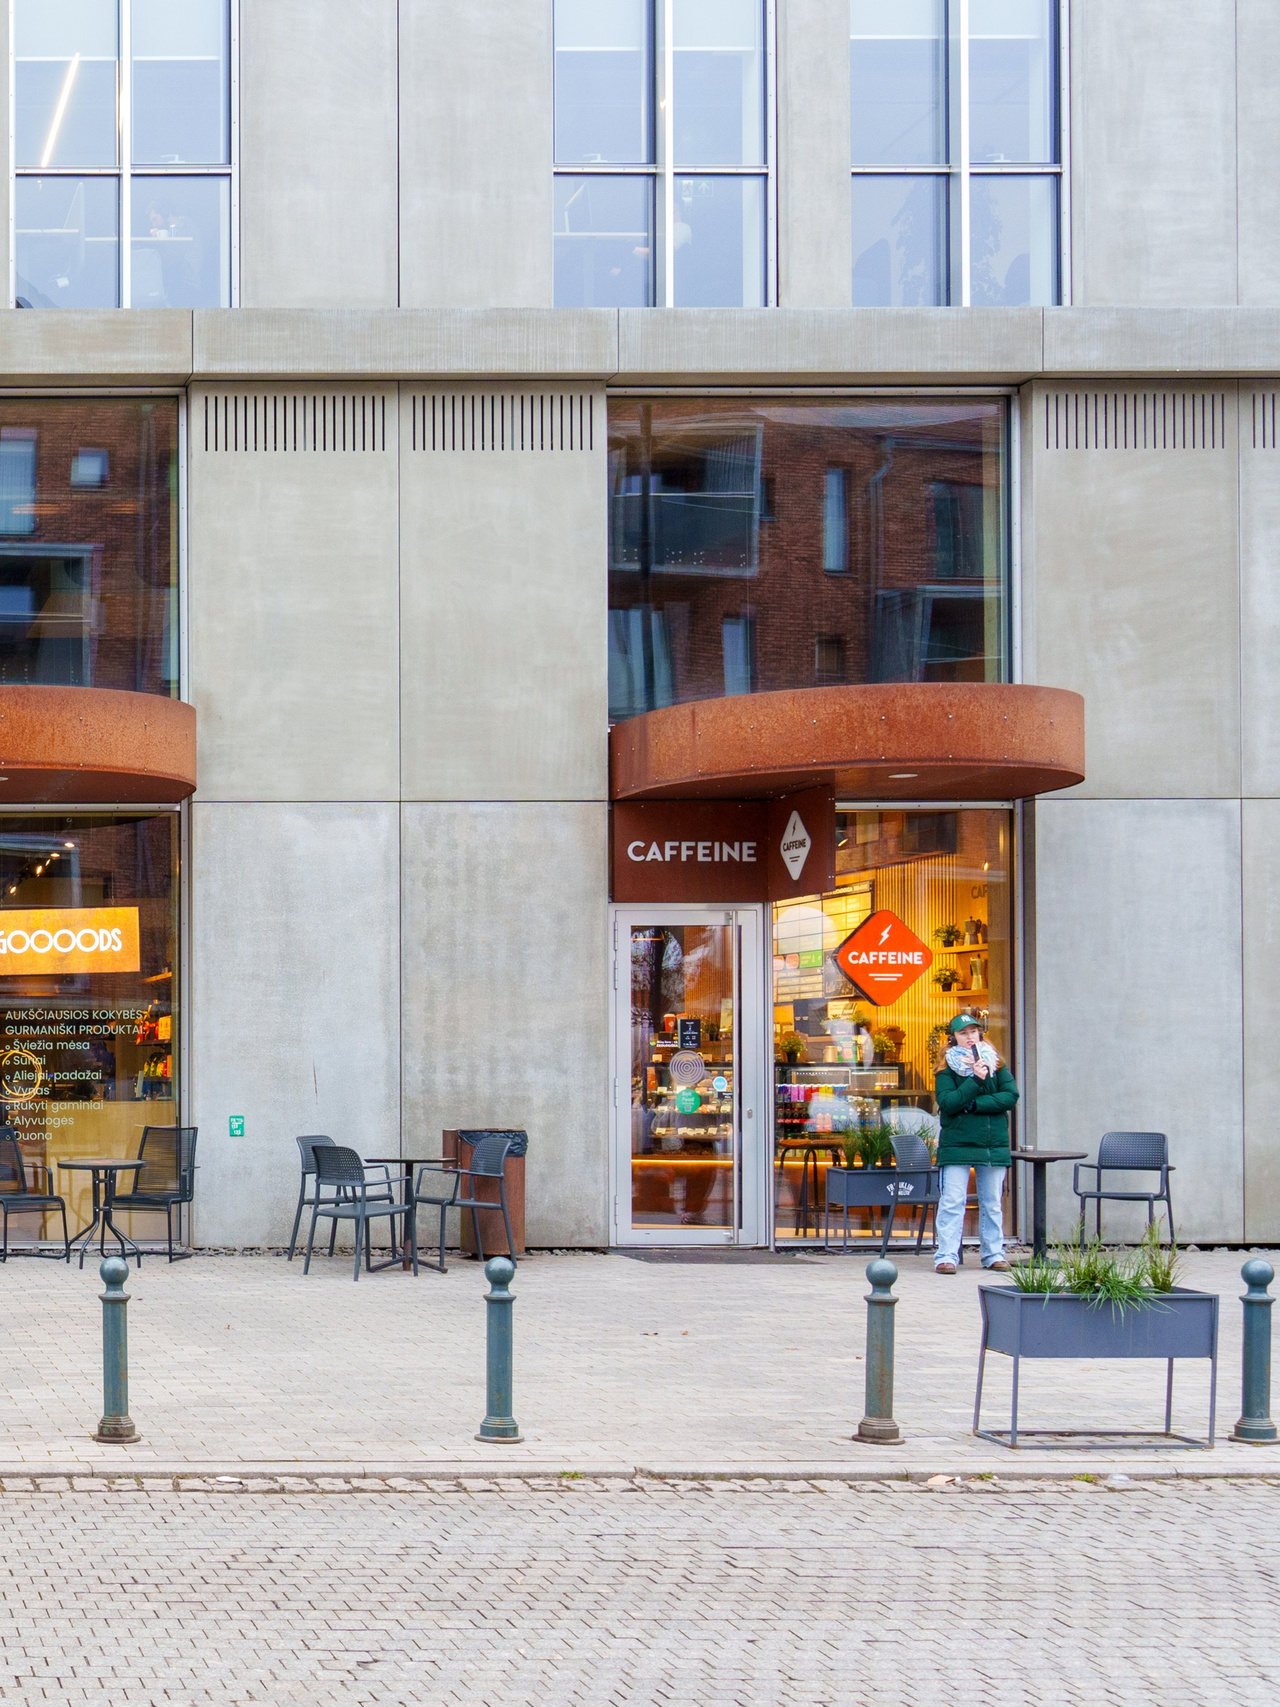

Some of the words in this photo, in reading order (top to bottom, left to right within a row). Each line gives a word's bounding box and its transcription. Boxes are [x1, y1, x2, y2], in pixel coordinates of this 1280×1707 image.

[783, 838, 806, 852] CAFFEINE
[627, 841, 757, 862] CAFFEINE
[848, 951, 923, 965] CAFFEINE
[5, 1008, 89, 1020] AUKŠČIAUSIOS
[92, 1008, 142, 1019] KOKYBĖS
[5, 1024, 75, 1035] GURMANIŠKI
[13, 1039, 53, 1050] Šviežia
[57, 1040, 90, 1050] mėsa
[13, 1071, 50, 1082] Aliejai,
[53, 1070, 102, 1082] padažai
[14, 1101, 47, 1112] Rūkyti
[51, 1101, 104, 1113] gaminiai
[14, 1116, 74, 1128] Alyvuogės
[14, 1131, 52, 1140] Duona
